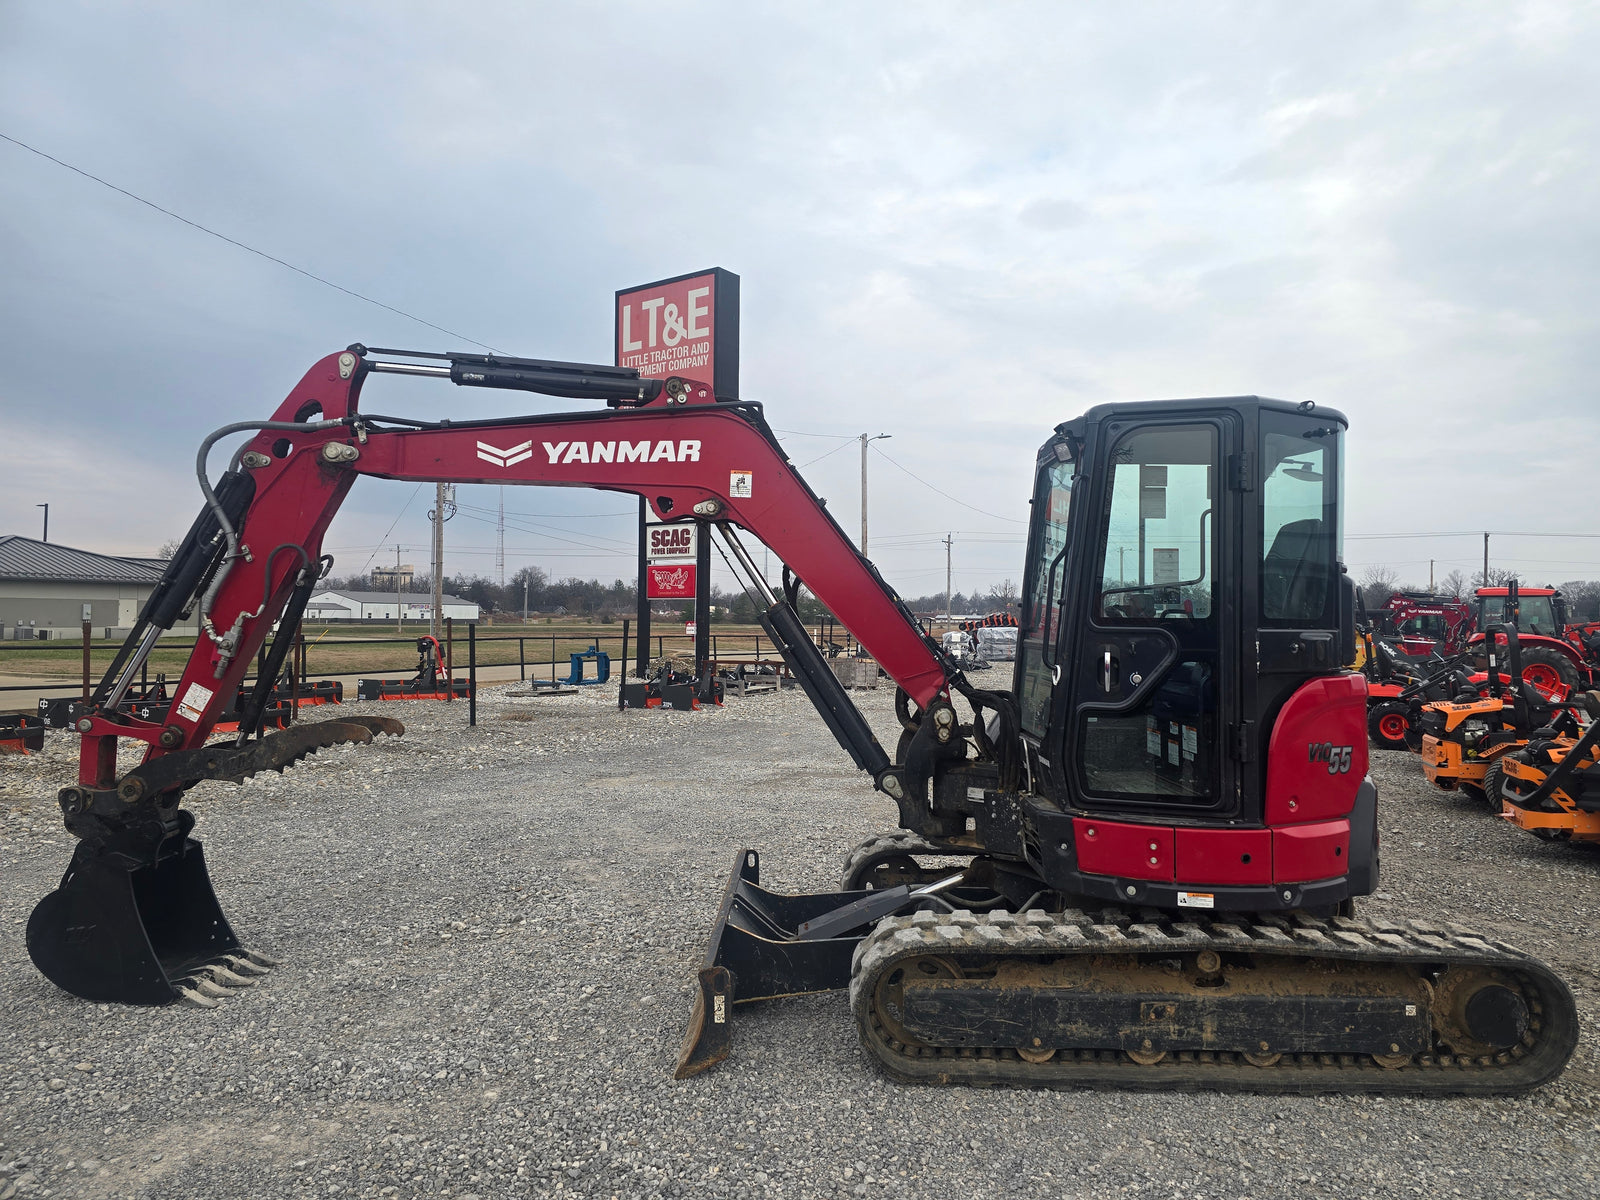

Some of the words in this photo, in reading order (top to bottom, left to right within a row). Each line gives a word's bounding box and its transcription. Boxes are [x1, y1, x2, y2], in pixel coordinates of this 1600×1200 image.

[622, 353, 649, 367] LITTLE
[650, 345, 689, 362] TRACTOR
[691, 341, 709, 355] AND
[637, 362, 667, 377] IPMENT
[668, 355, 709, 371] COMPANY
[542, 440, 701, 463] YANMAR
[651, 529, 691, 548] SCAG
[666, 547, 690, 555] EQUIPMENT
